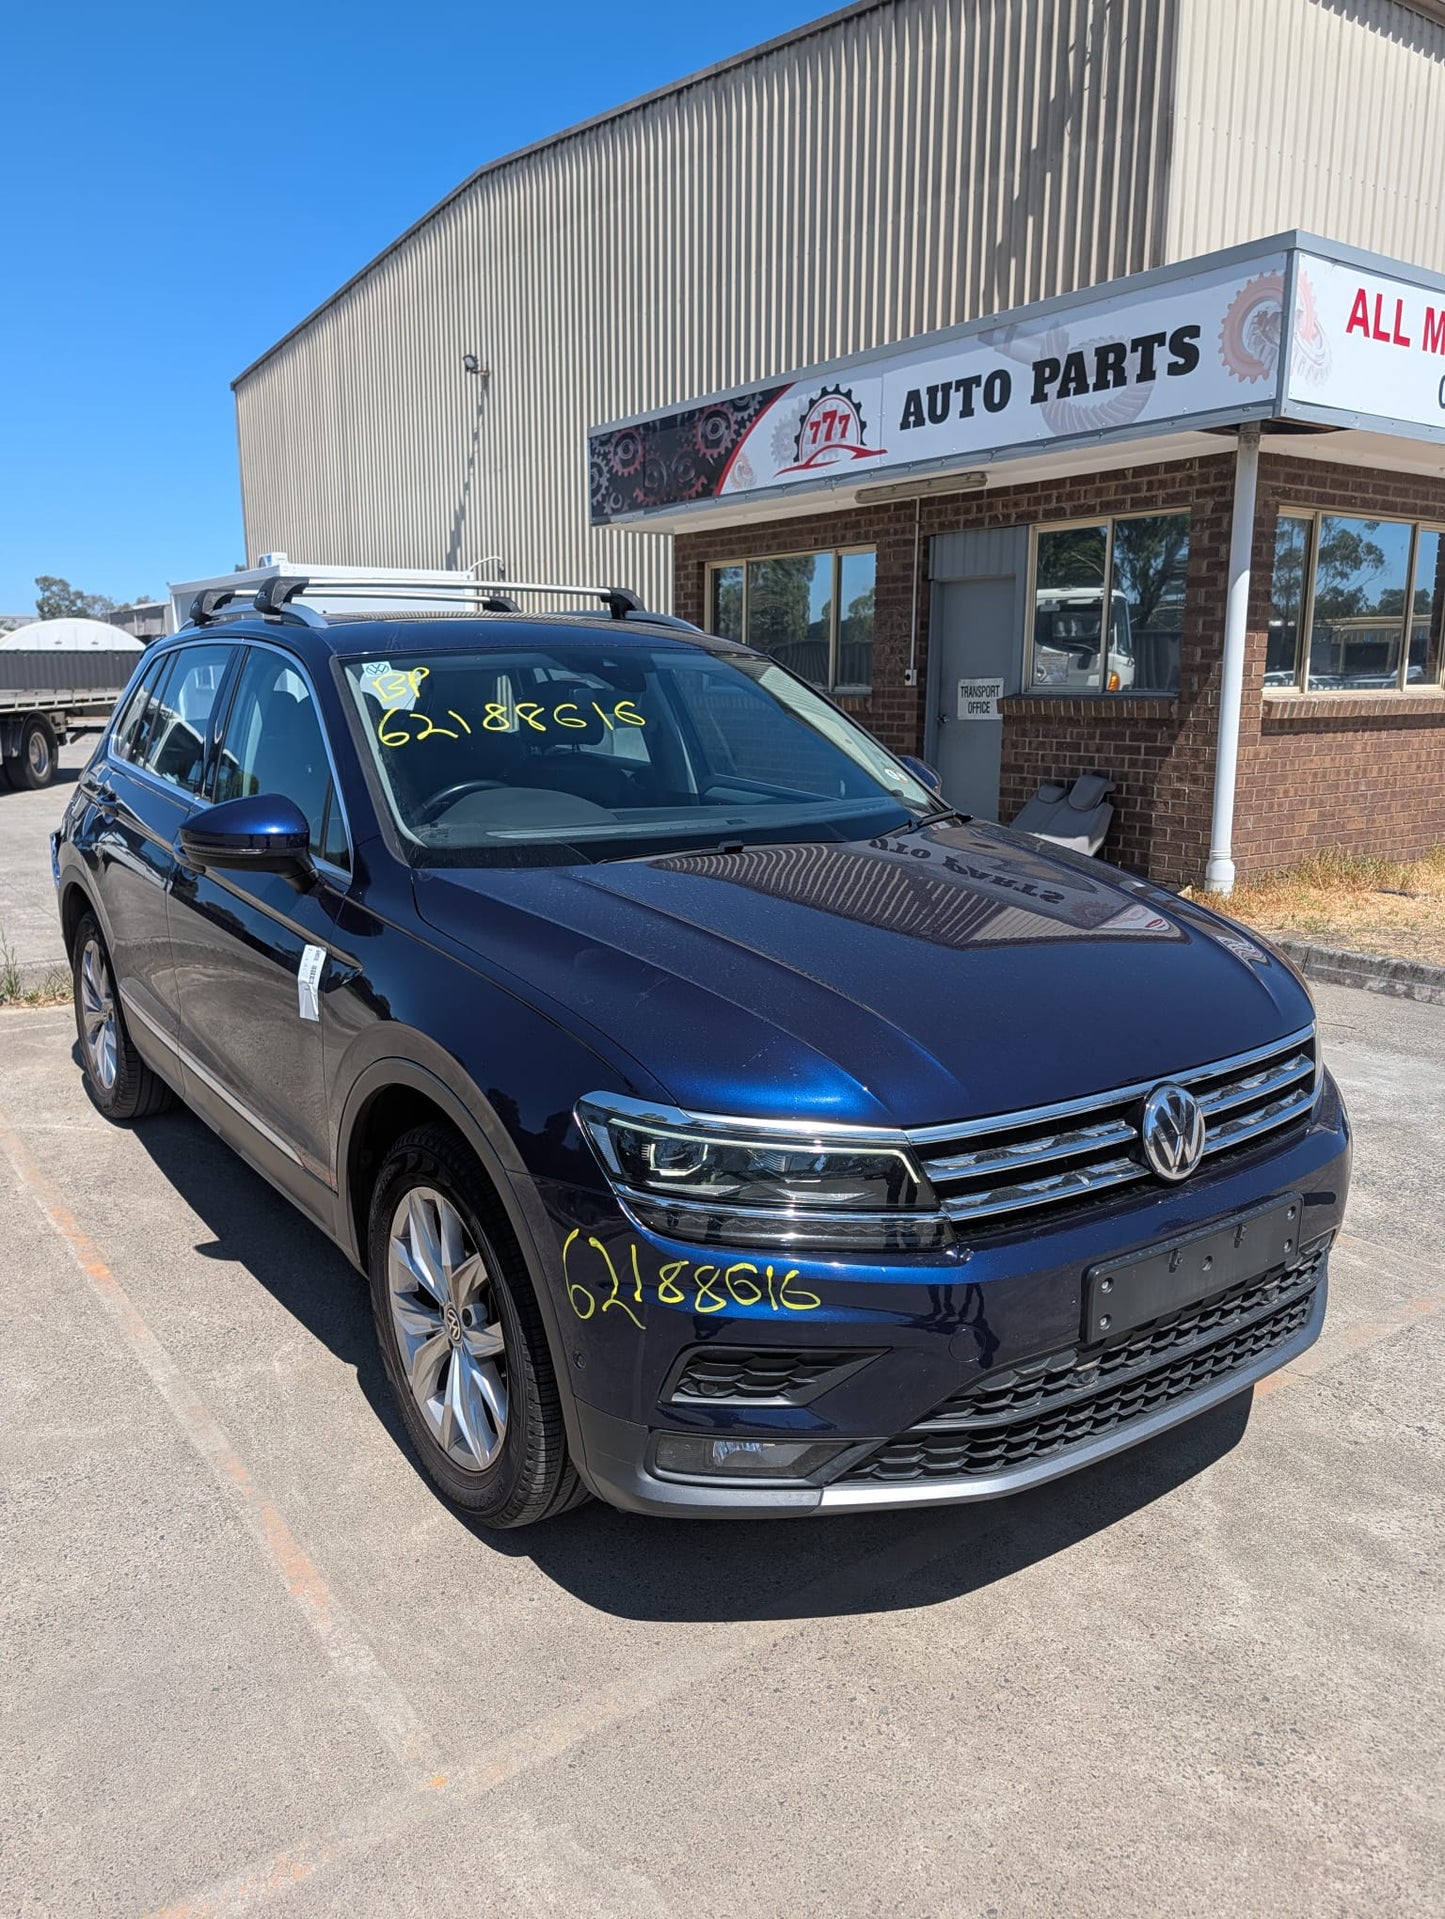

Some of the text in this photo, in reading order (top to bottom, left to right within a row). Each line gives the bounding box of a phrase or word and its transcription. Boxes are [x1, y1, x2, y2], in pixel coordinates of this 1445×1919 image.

[1345, 287, 1411, 348] ALL
[809, 324, 1202, 445] 777 AUTO PARTS
[960, 684, 1001, 698] TRANSPORT
[967, 701, 991, 714] OFFICE
[378, 701, 646, 747] 62188616
[562, 1228, 822, 1330] 62188616
